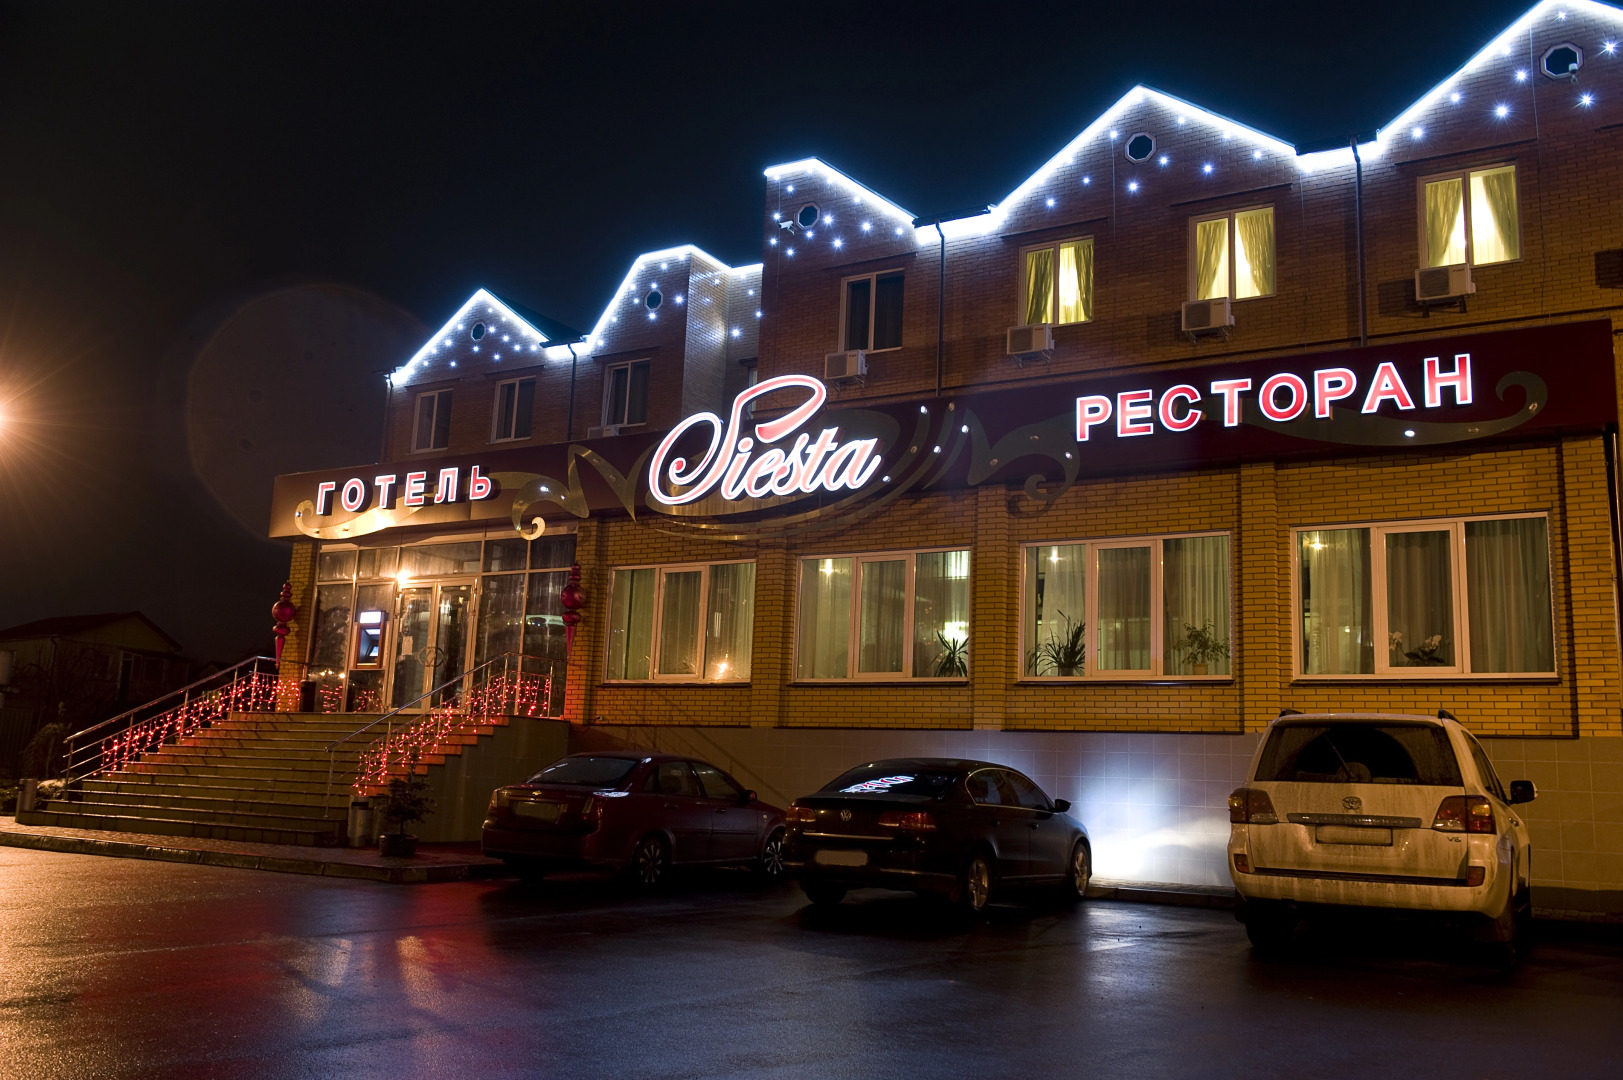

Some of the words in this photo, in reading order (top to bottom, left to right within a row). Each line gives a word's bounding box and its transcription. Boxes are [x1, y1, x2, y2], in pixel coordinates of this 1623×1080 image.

[648, 374, 882, 505] Siesta
[1075, 353, 1473, 442] РЕСТОРАН
[316, 465, 492, 515] ГОТЕЛЬ
